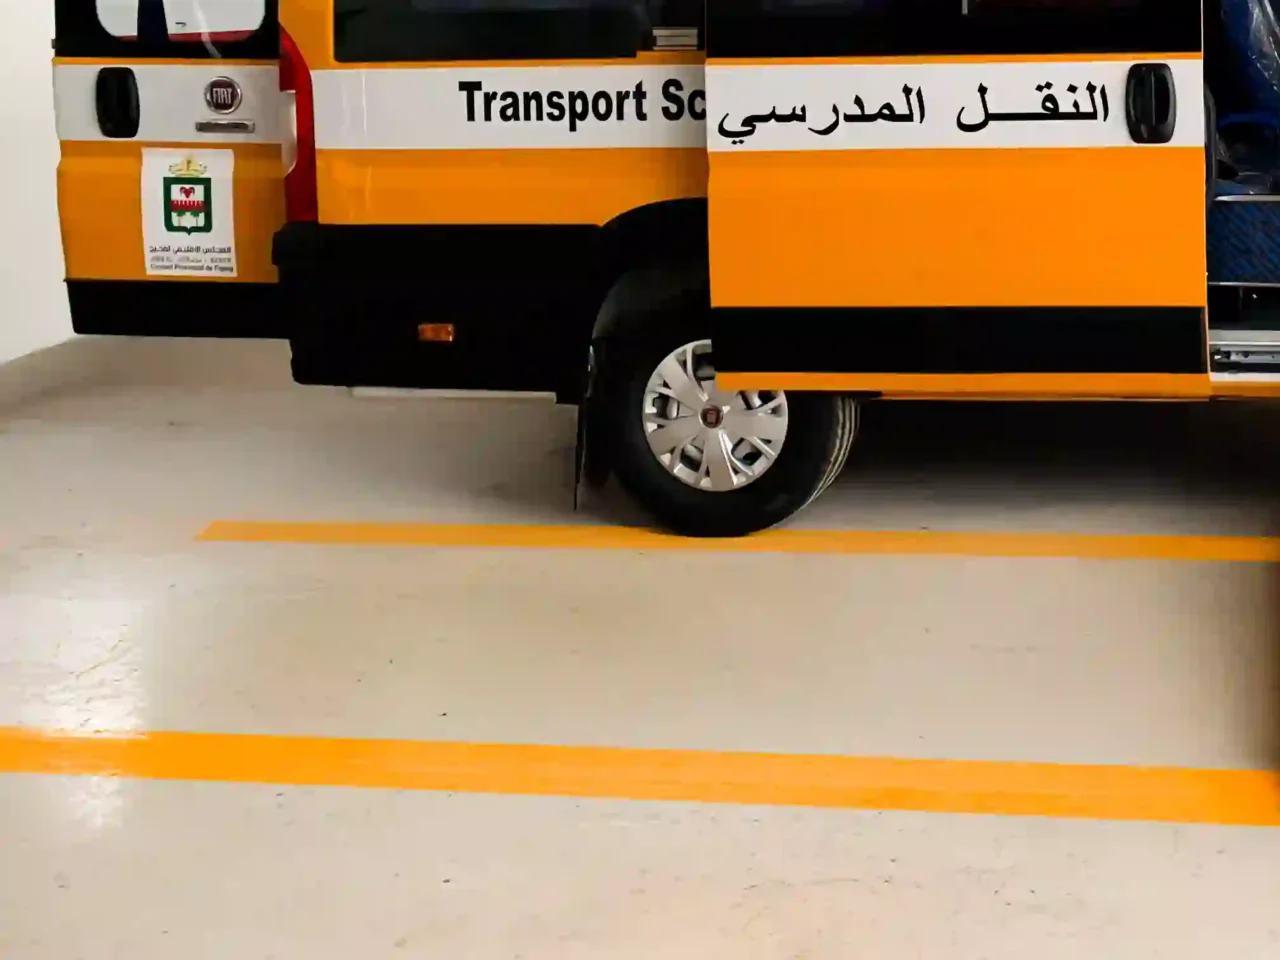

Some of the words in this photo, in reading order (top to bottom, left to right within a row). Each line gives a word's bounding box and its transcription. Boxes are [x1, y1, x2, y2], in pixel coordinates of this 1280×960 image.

[212, 87, 233, 104] FIAT
[458, 79, 647, 132] Transport
[717, 82, 926, 145] المدرسي
[956, 80, 1110, 133] النقل
